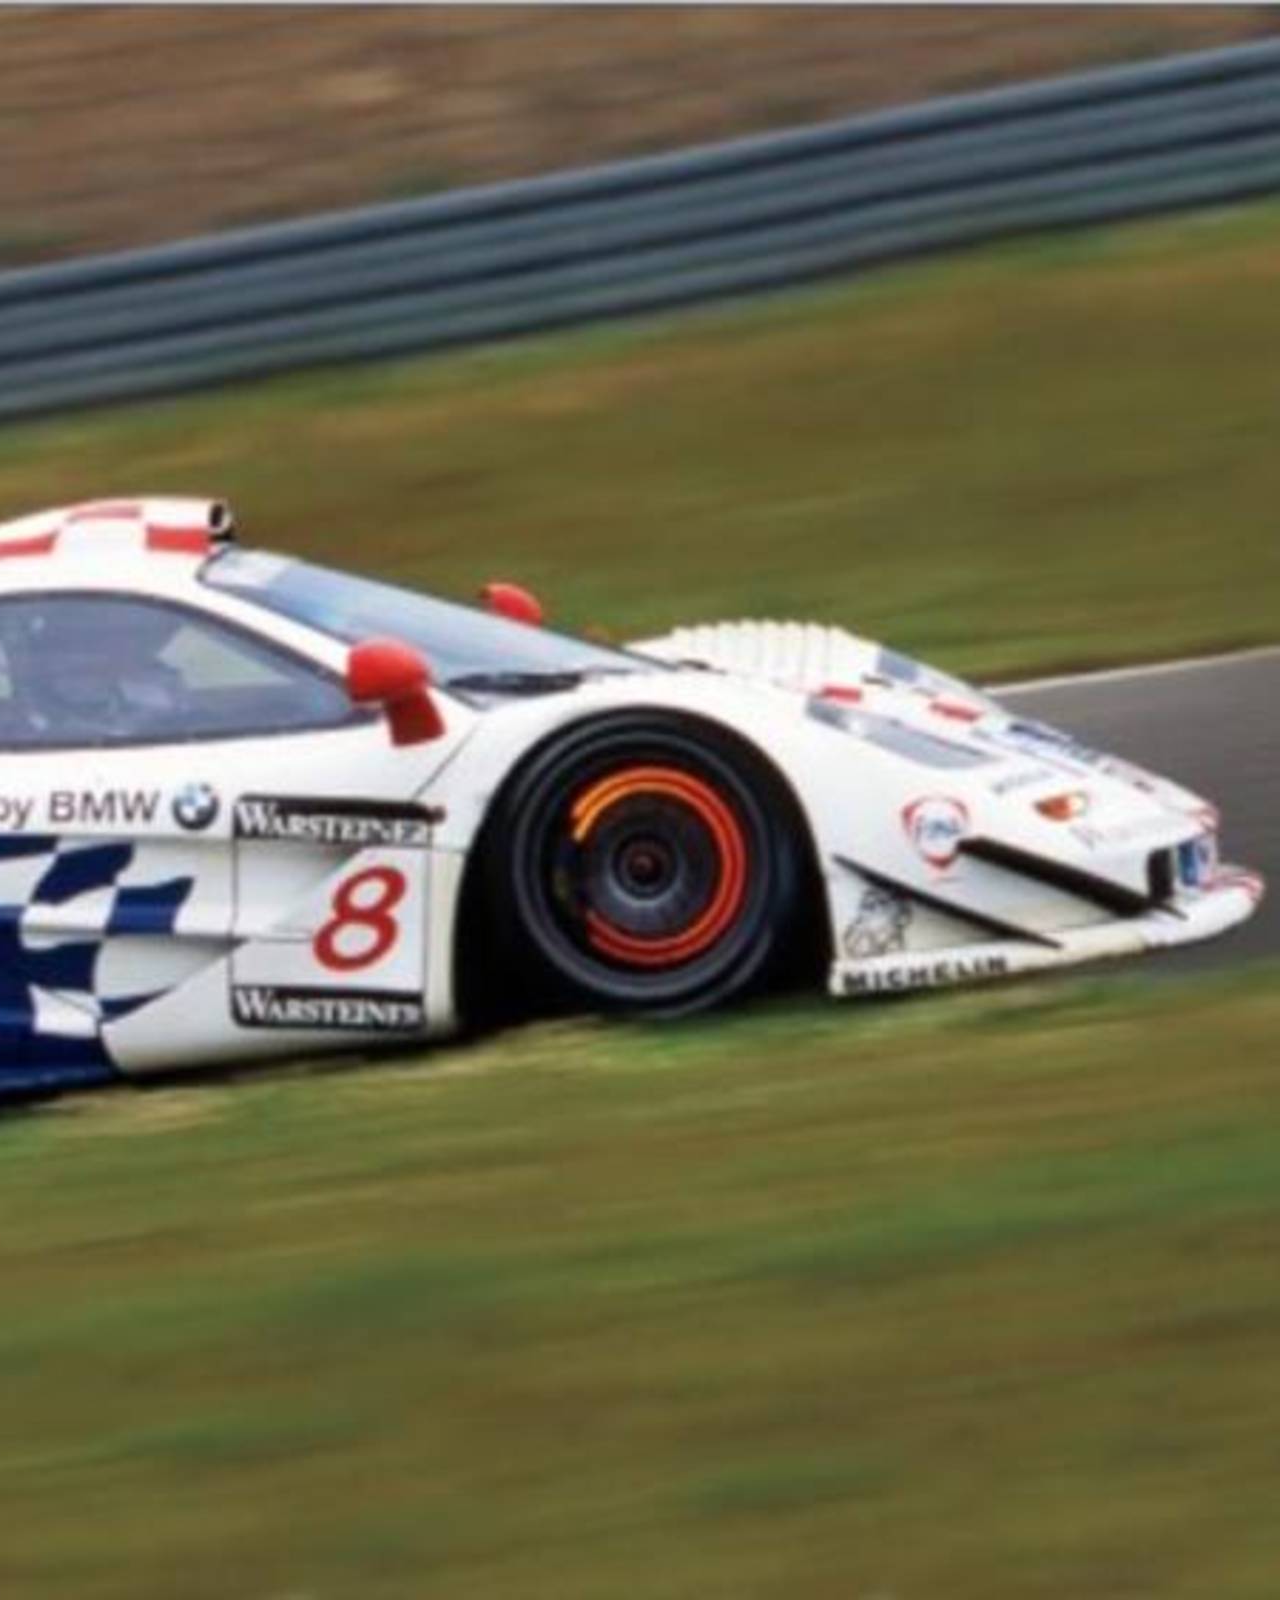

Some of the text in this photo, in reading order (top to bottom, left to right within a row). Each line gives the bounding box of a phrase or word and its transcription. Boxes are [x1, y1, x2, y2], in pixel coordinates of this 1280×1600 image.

[49, 790, 161, 822] BMW
[313, 866, 406, 973] 8
[842, 955, 1009, 993] MICHELIN
